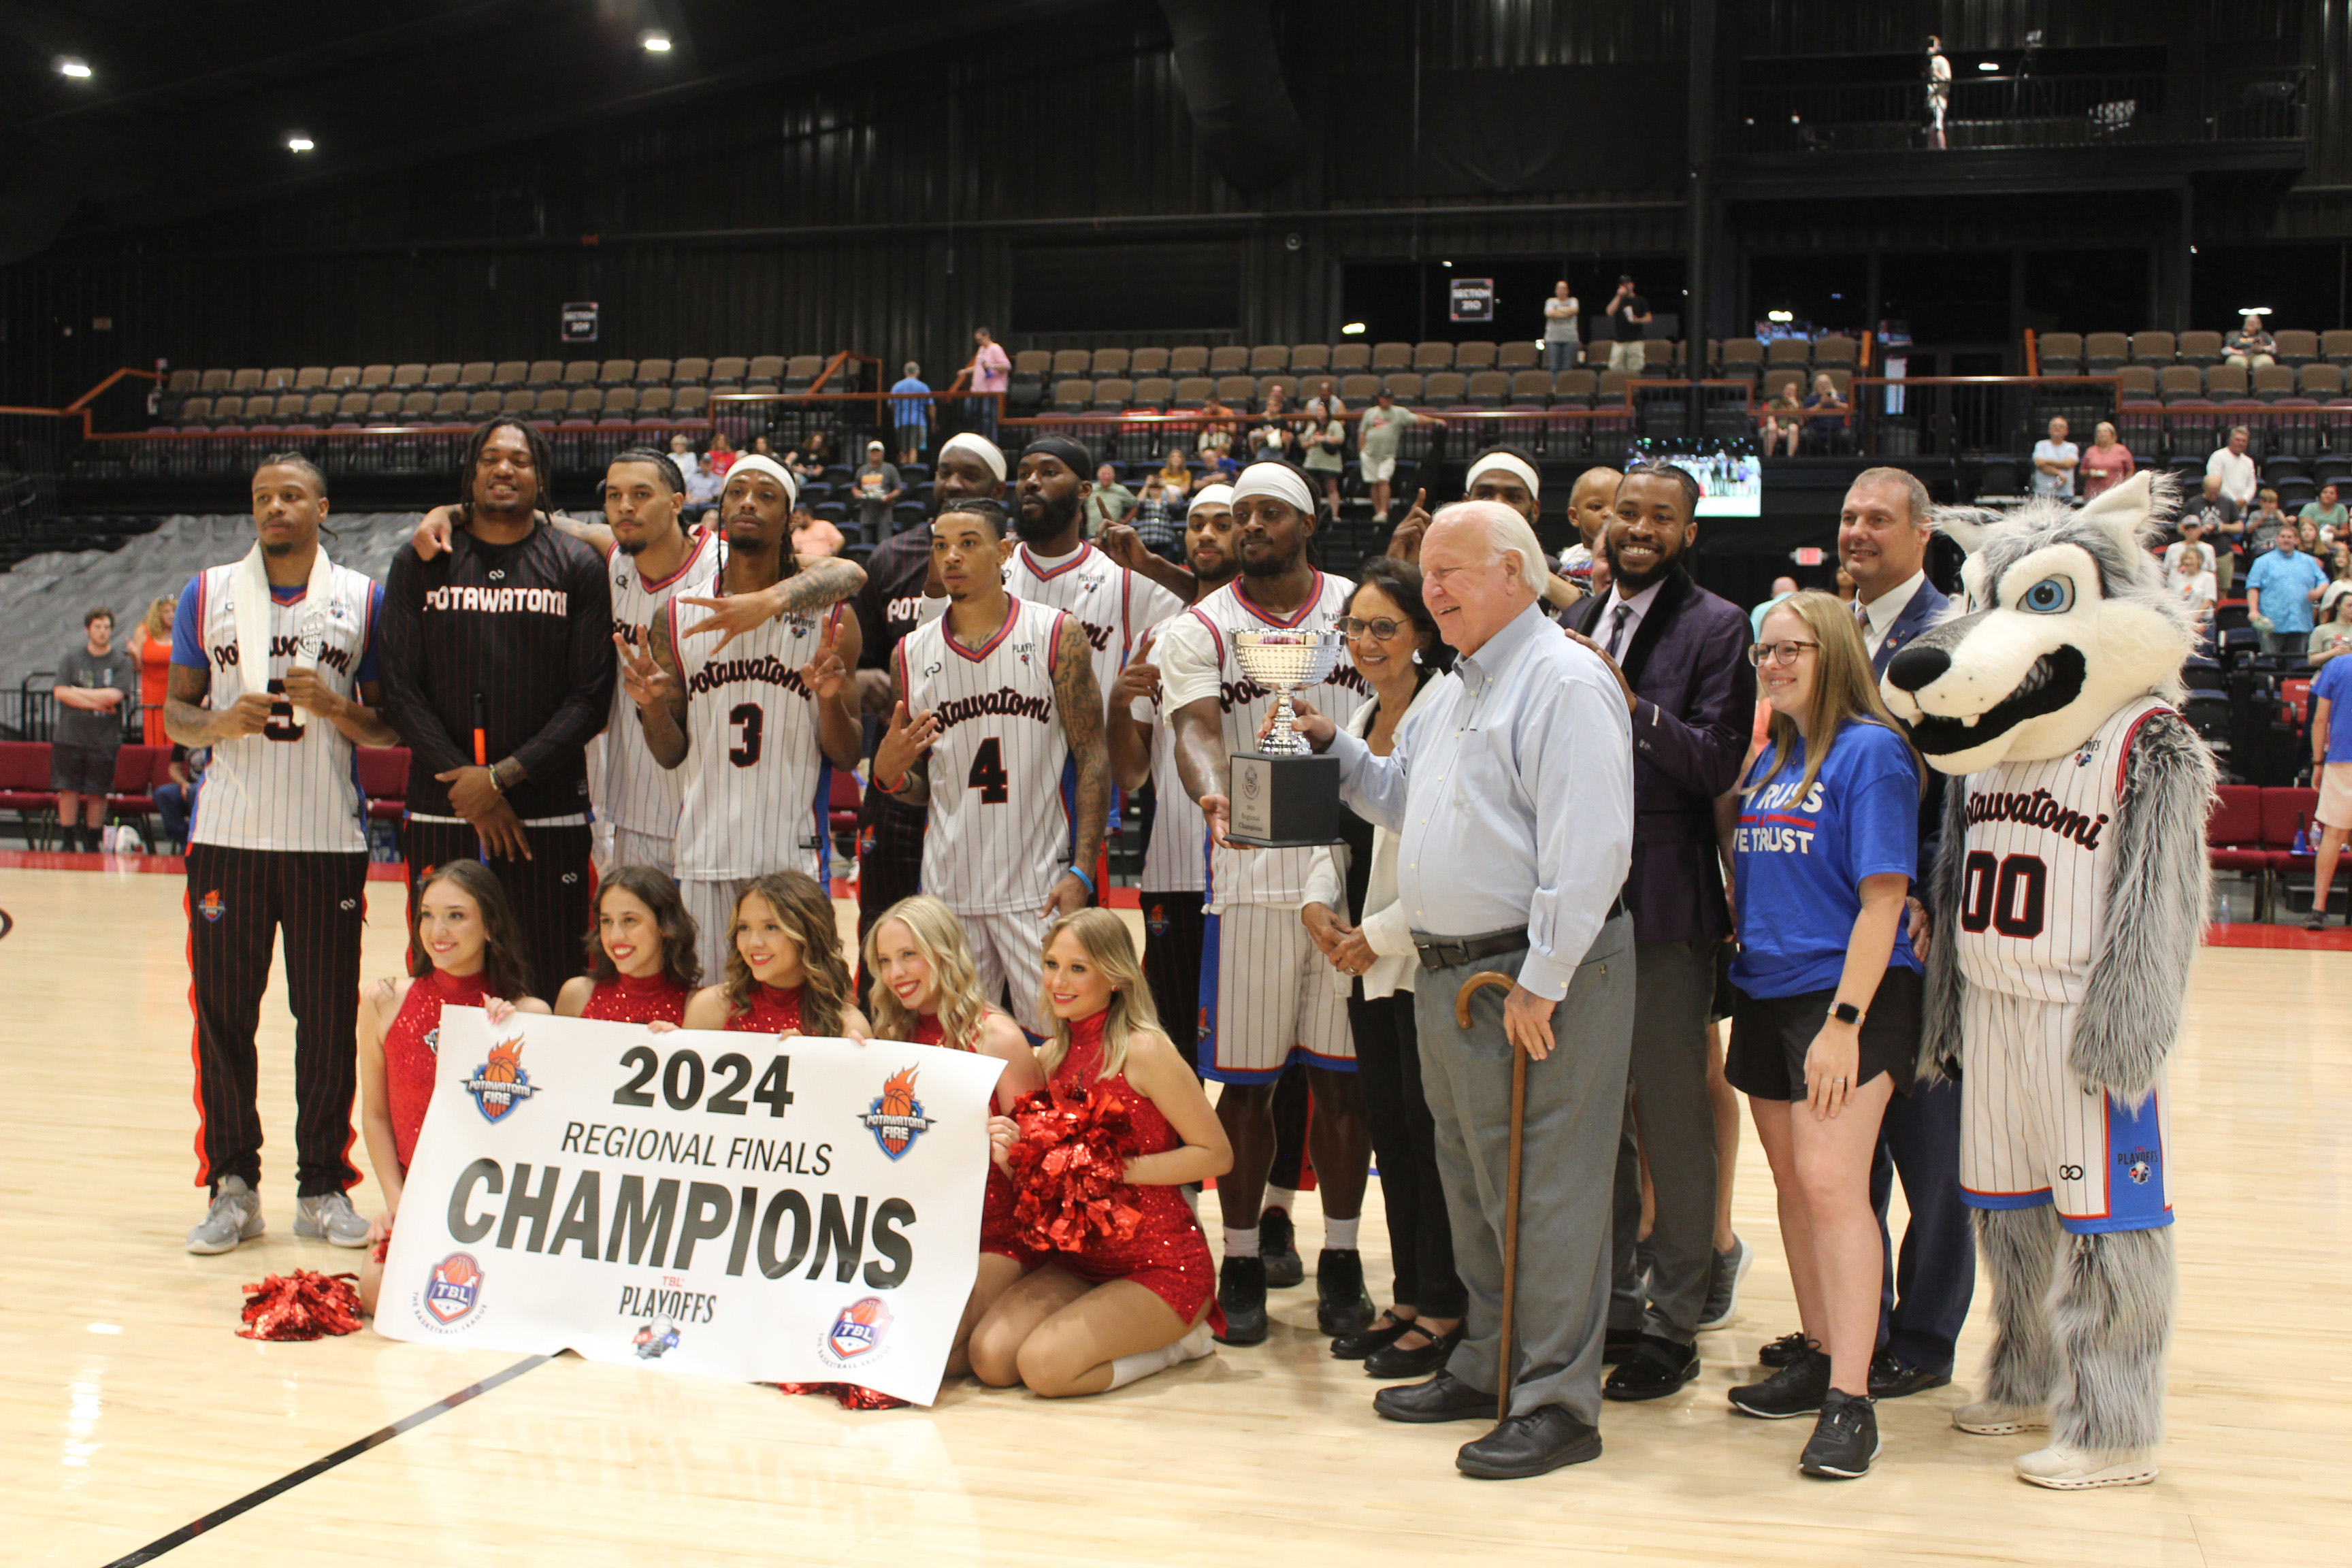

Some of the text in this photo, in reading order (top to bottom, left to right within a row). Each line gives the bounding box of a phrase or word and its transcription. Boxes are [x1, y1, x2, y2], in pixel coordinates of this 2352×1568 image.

[1452, 289, 1491, 299] SECTION
[926, 686, 1052, 736] otawatomi
[730, 702, 763, 767] 3
[968, 736, 1008, 804] 4
[1756, 781, 1825, 813] RUSS
[1239, 821, 1262, 832] Champions
[1751, 826, 1814, 854] TRUST
[1961, 850, 2047, 939] 00
[468, 1080, 531, 1096] POTAWATOMI
[613, 1046, 794, 1118] 2024
[483, 1091, 510, 1106] FIRE
[866, 1114, 928, 1130] POTAWATOMI
[882, 1126, 909, 1141] FIRE
[561, 1121, 832, 1176] REGIONAL FINALS
[446, 1157, 917, 1290] CHAMPIONS
[437, 1283, 470, 1303] TBL
[618, 1285, 717, 1324] PLAYOFFS
[841, 1323, 872, 1341] TBL
